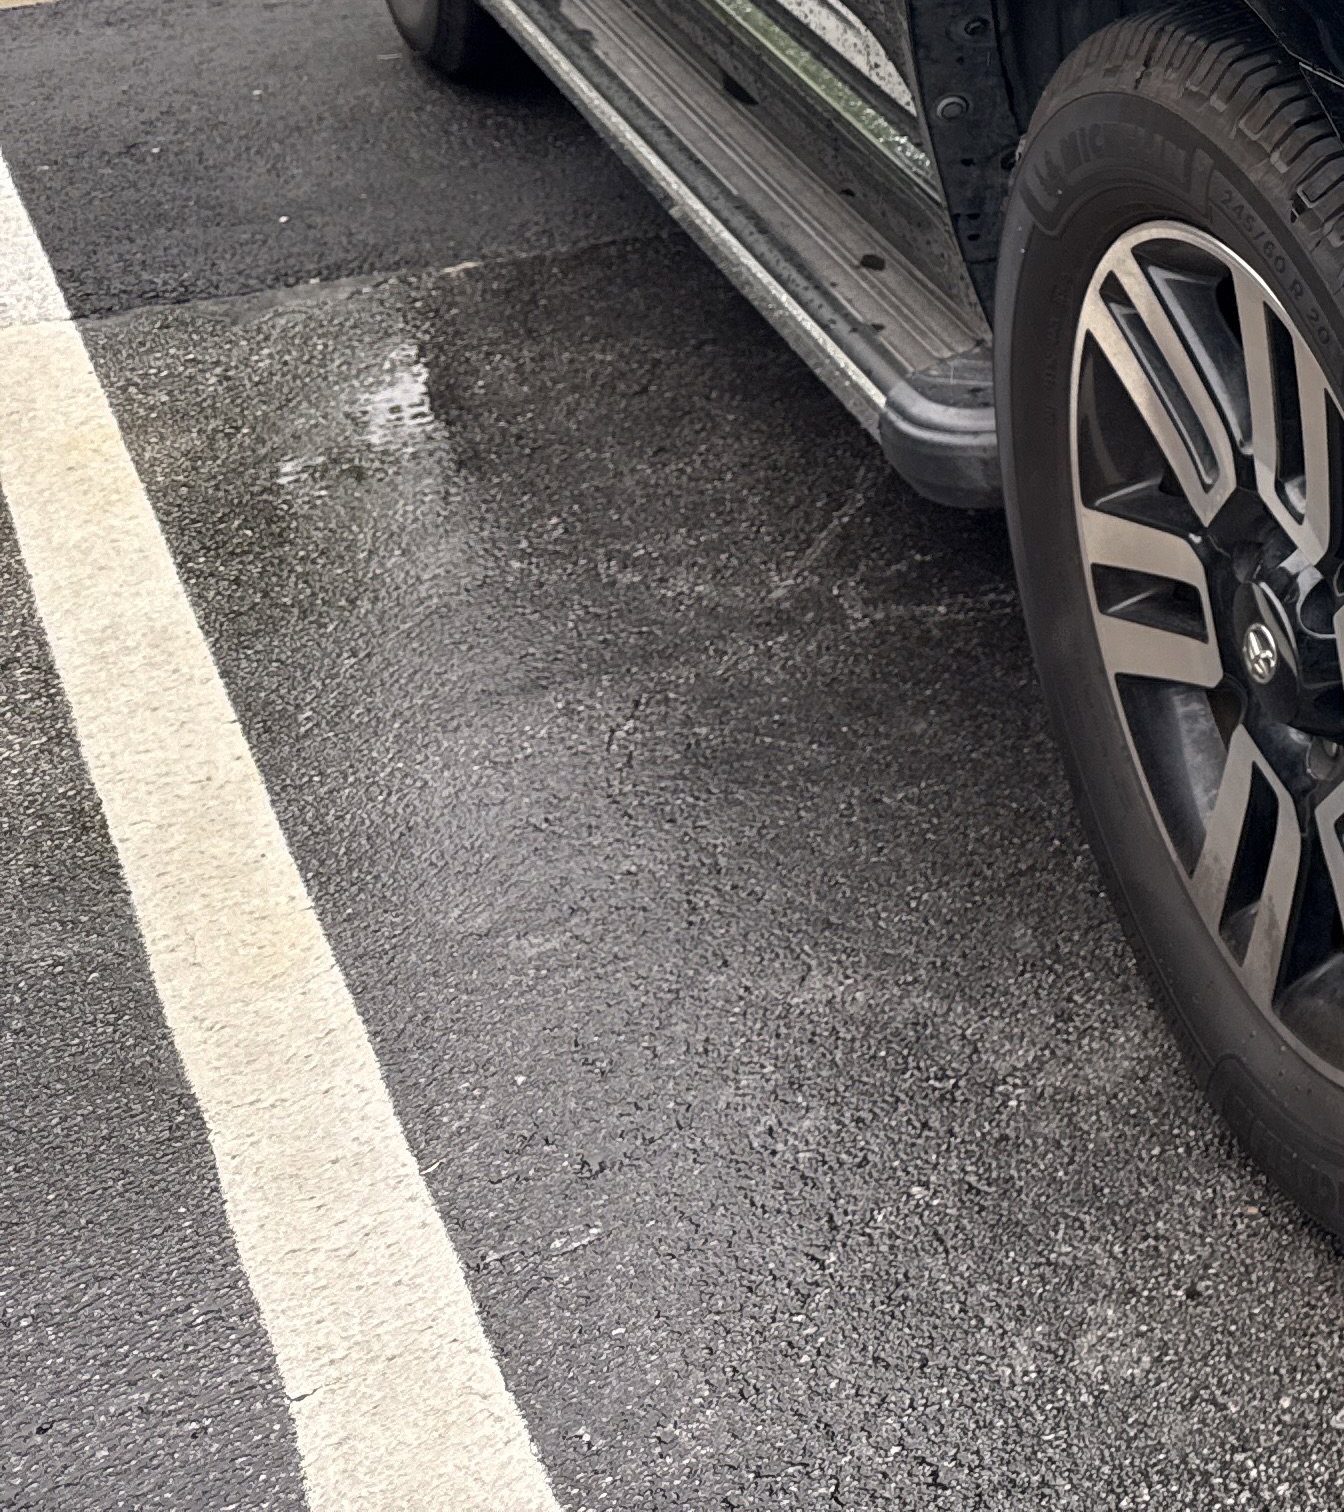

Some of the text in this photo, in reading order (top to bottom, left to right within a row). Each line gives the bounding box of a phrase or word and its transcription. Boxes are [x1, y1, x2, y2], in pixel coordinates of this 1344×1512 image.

[1220, 190, 1332, 345] 245/60 R 20
